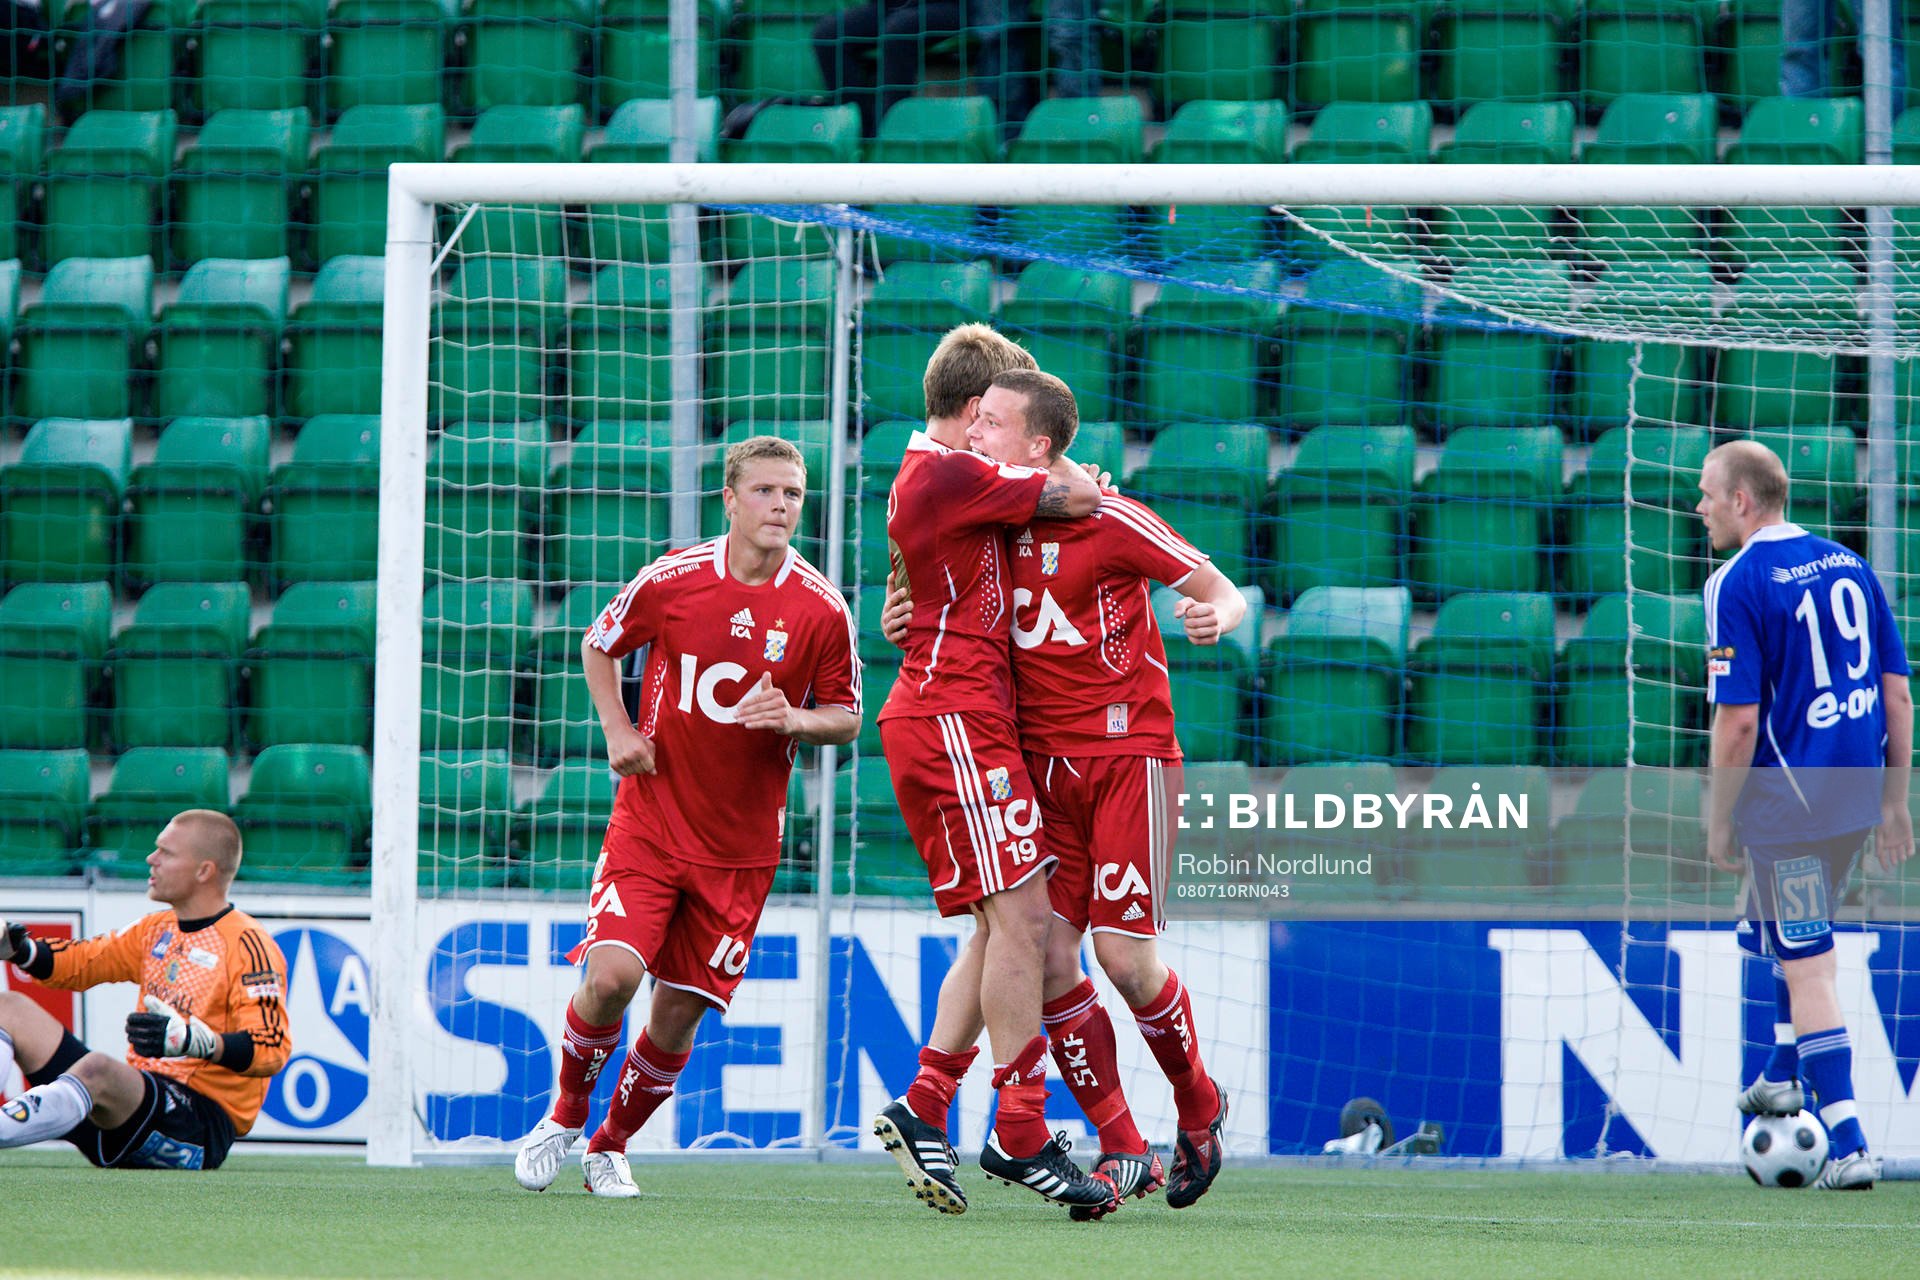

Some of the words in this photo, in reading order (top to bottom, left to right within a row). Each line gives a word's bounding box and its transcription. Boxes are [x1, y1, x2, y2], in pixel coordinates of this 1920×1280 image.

[1019, 545, 1033, 557] ICA
[651, 569, 677, 584] TEAM
[801, 577, 824, 596] TEAM
[730, 624, 752, 640] ICA
[1010, 587, 1088, 650] CA
[1795, 578, 1871, 690] 19
[1005, 838, 1038, 866] 19
[588, 881, 627, 918] CA
[1093, 861, 1150, 901] ICA
[1782, 873, 1820, 920] ST
[1063, 1032, 1099, 1088] SKF
[282, 1058, 330, 1123] O
